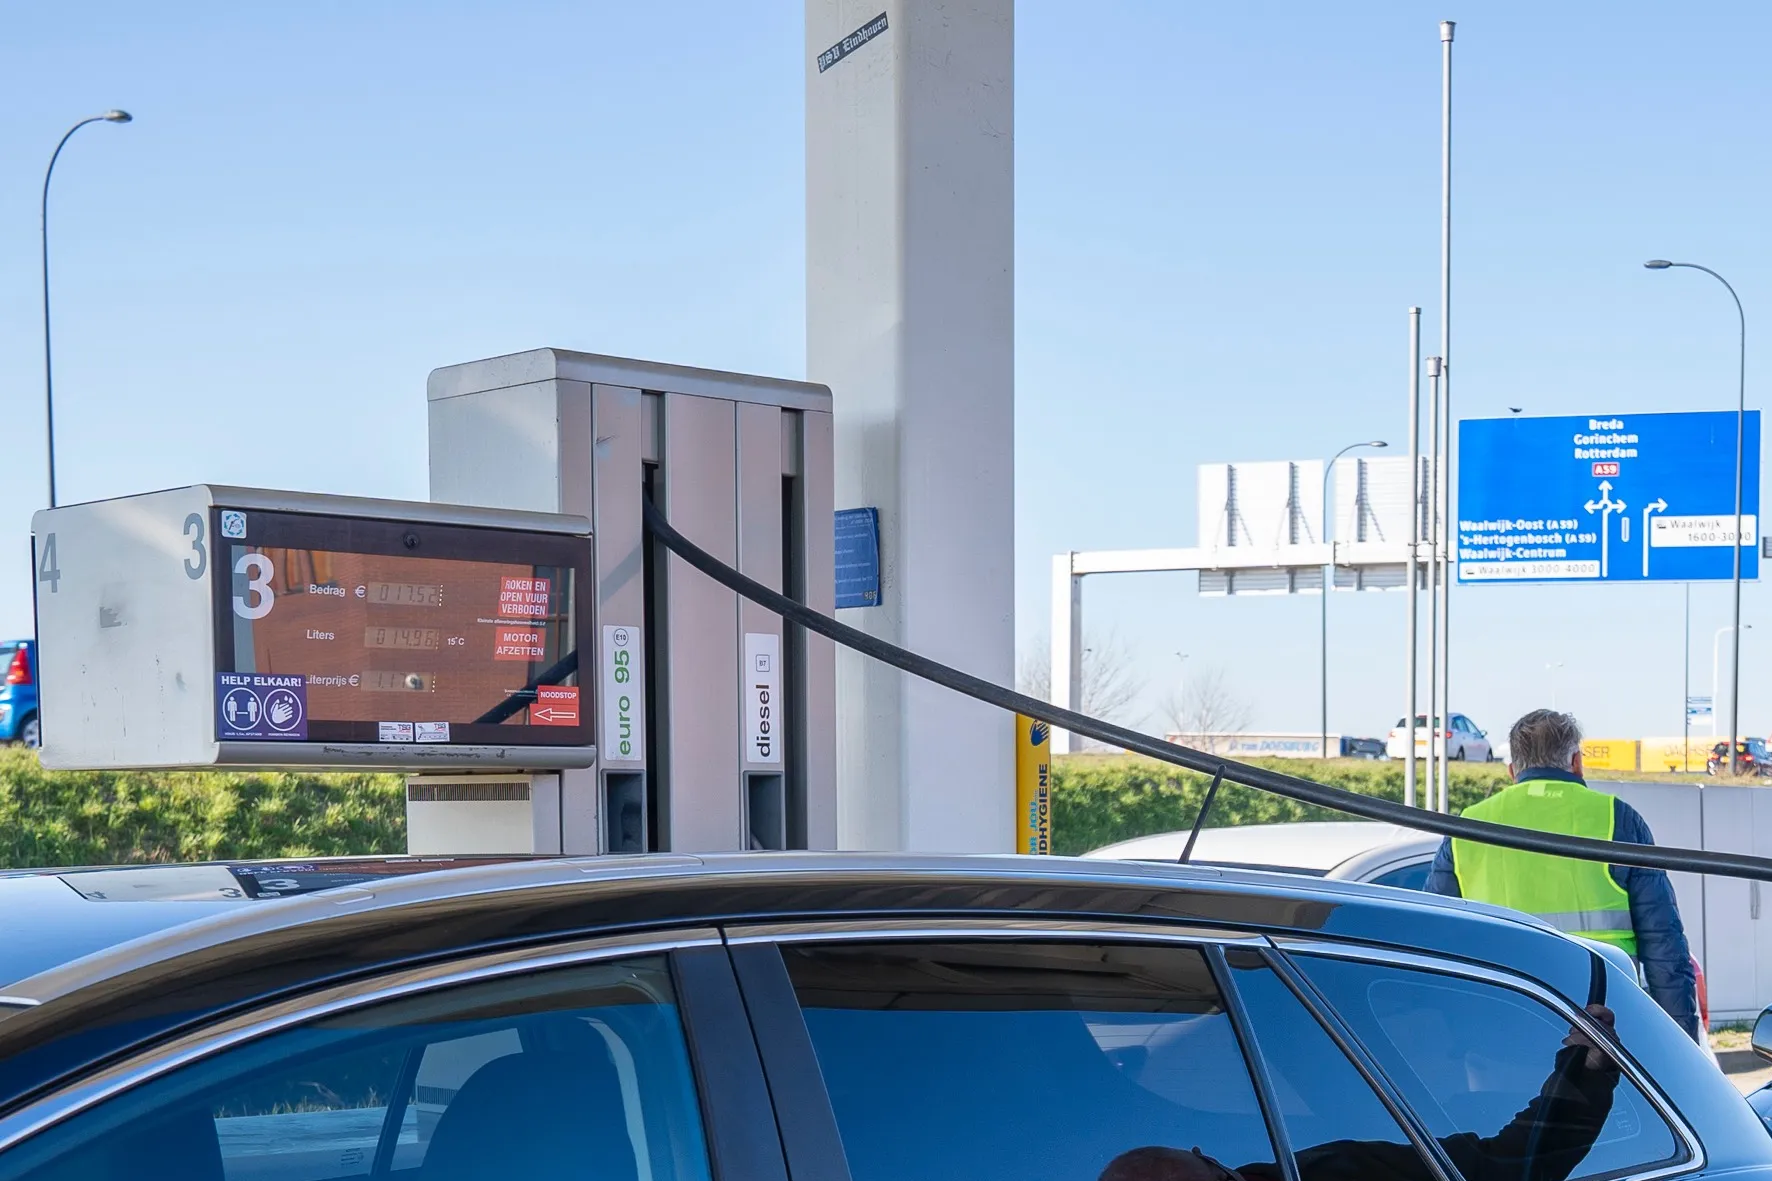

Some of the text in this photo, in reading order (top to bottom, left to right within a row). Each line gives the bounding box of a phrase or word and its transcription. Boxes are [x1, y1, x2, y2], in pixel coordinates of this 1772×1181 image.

[1589, 419, 1624, 430] Breda
[1574, 433, 1638, 445] Gorinchem
[1575, 447, 1637, 459] Rotterdam
[1593, 464, 1617, 475] A59
[1460, 520, 1544, 533] Waalwijk-Oost
[1688, 531, 1751, 542] 1600-300
[183, 512, 207, 580] 3
[1460, 547, 1567, 561] Waalwijk-Centrum
[39, 532, 61, 593] 4
[232, 553, 275, 620] 3
[309, 584, 346, 598] Bedrag
[505, 580, 546, 592] ROKEN EN
[501, 592, 548, 603] OPEN VUUR
[502, 603, 546, 615] VERBODEN
[306, 630, 335, 640] Liters
[504, 633, 538, 643] MOTOR
[496, 646, 544, 656] AFZETTEN
[221, 676, 302, 687] HELP ELKAAR!
[540, 691, 577, 699] NOODSTOP
[614, 650, 631, 756] euro 95
[756, 684, 771, 757] diesel
[1583, 746, 1611, 758] SER
